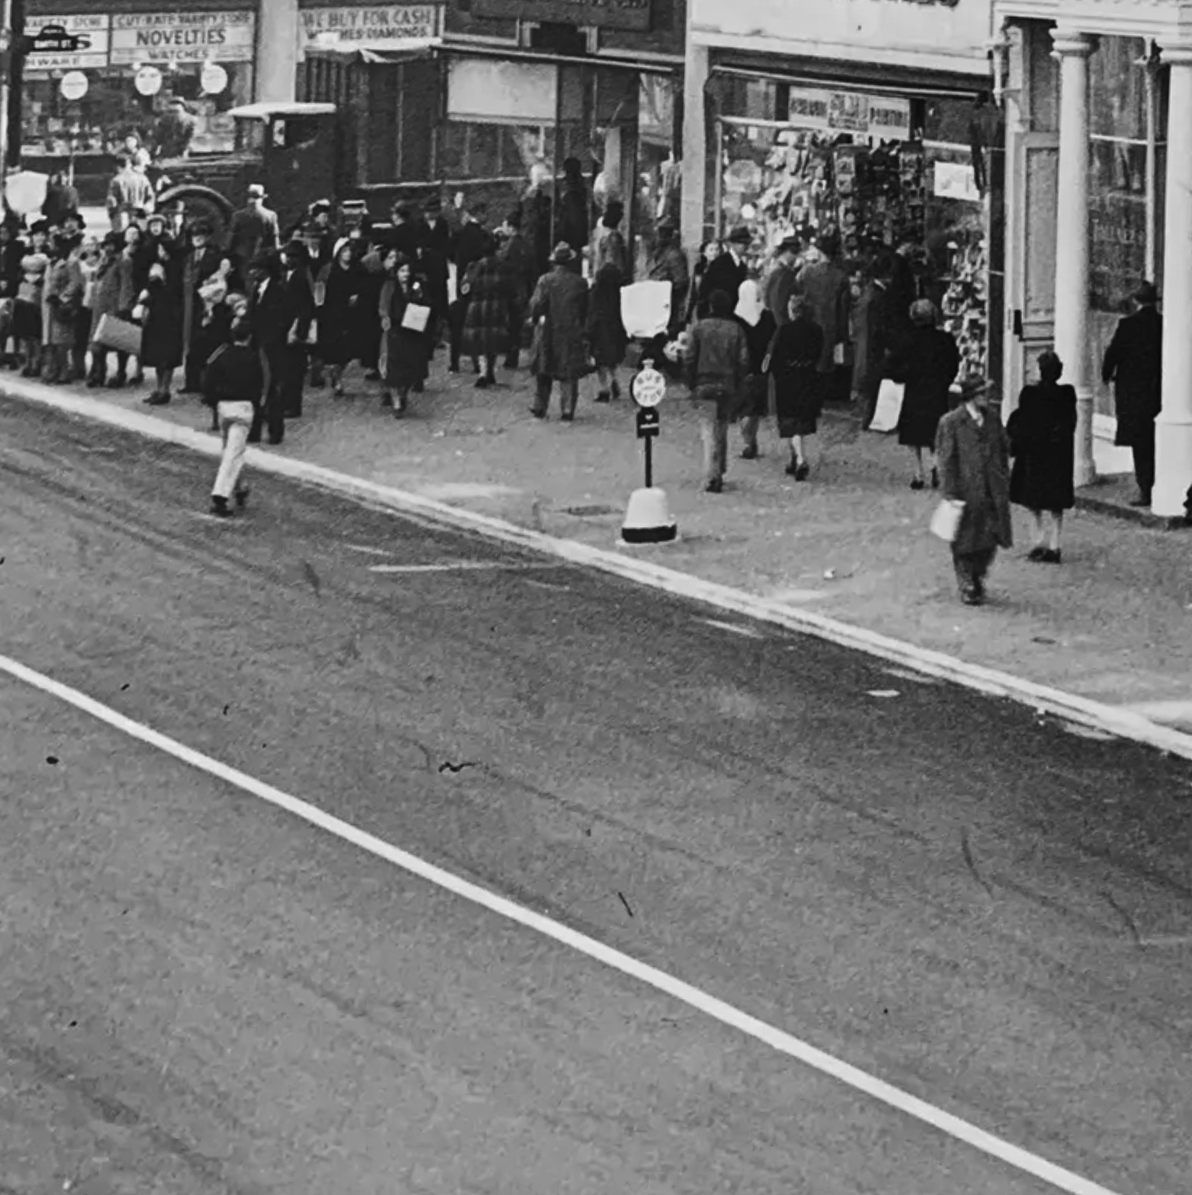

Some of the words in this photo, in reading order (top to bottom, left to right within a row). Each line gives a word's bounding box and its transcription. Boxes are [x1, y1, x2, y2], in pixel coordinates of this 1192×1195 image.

[394, 8, 431, 24] CASH
[136, 29, 226, 47] NOVELTIES
[148, 49, 208, 60] WATCHES
